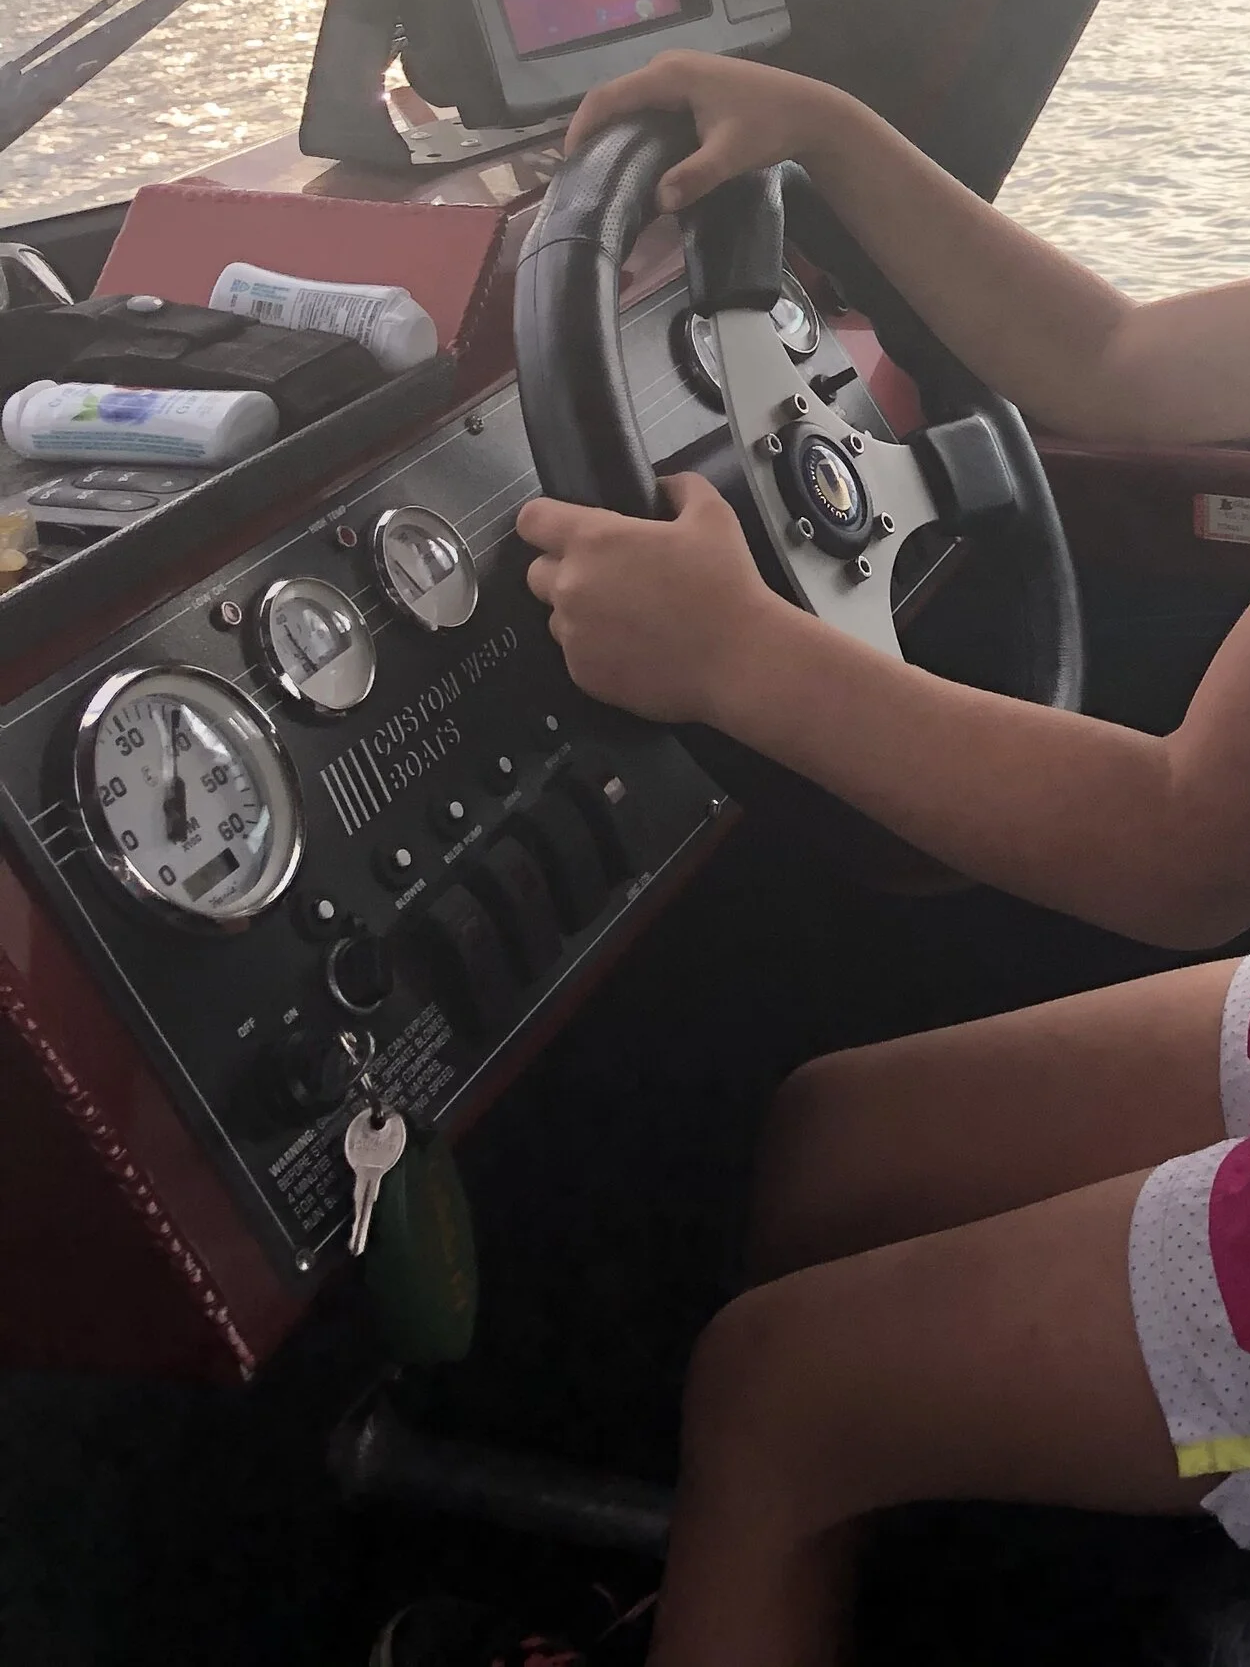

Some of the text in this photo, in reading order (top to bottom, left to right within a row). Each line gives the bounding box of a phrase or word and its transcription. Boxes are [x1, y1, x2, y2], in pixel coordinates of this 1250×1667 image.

[191, 583, 227, 609] LOW OIL
[115, 727, 145, 756] 30
[97, 777, 128, 807] 20
[200, 765, 229, 793] 50
[218, 812, 245, 841] 60
[158, 865, 177, 886] 0
[395, 877, 427, 910] BLOWER
[237, 1016, 256, 1038] OFF
[282, 1007, 299, 1025] ON
[427, 1064, 455, 1096] SPEED
[276, 1154, 311, 1191] BEFORE
[381, 1045, 416, 1083] OPERATE
[269, 1127, 316, 1176] WARNING:
